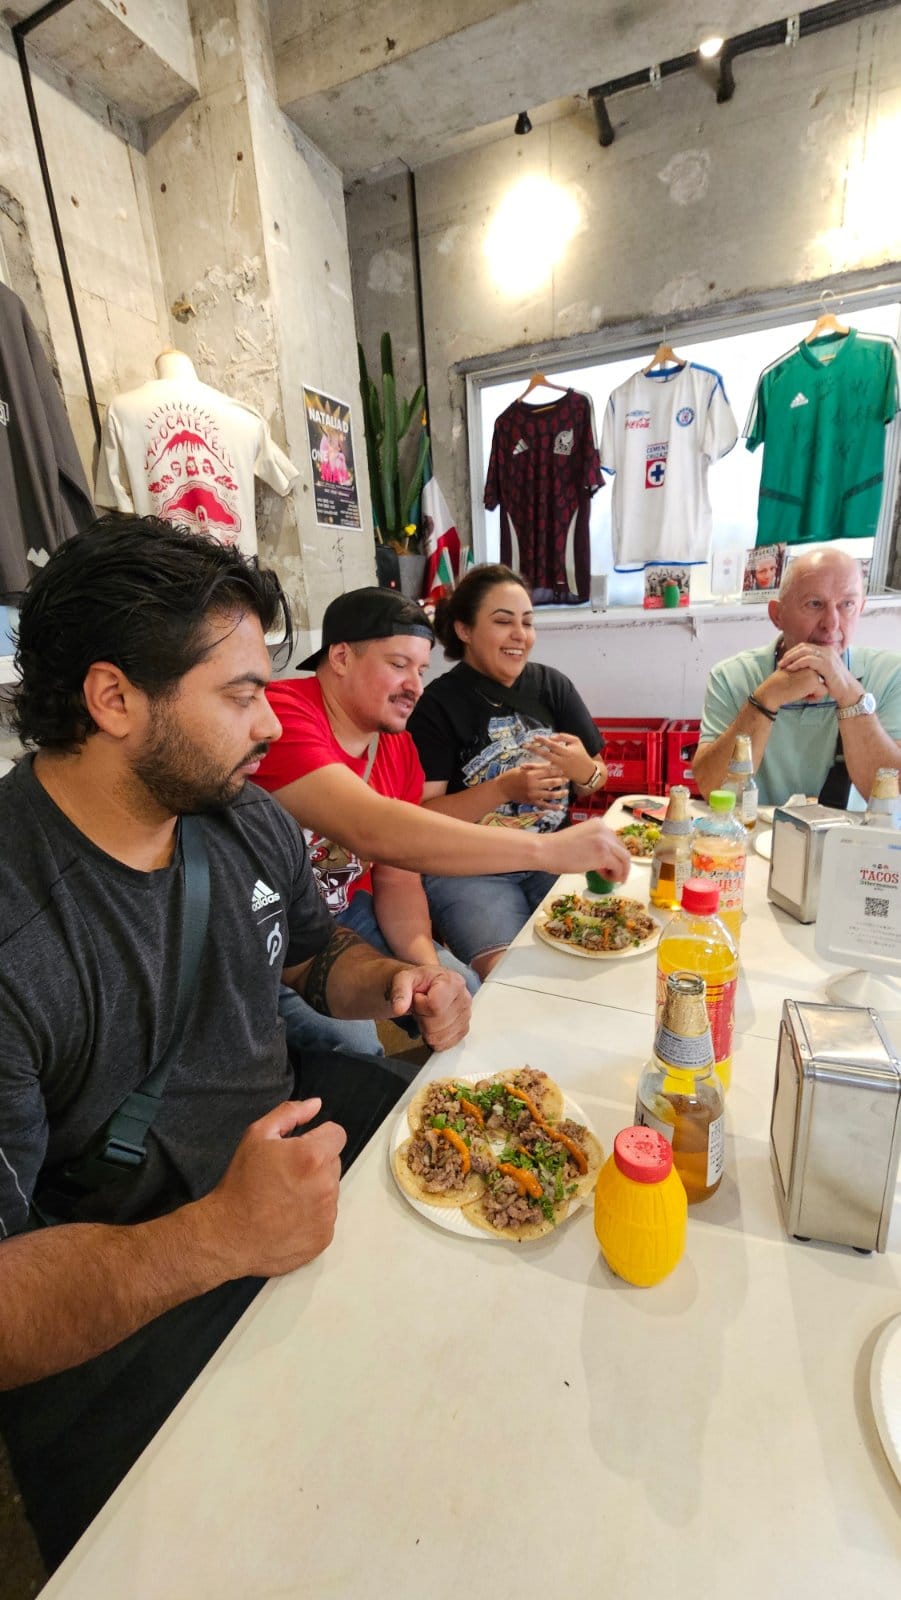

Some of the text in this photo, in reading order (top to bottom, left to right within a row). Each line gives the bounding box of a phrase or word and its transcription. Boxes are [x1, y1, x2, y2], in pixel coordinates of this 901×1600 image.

[646, 445, 669, 454] CEMENT
[859, 869, 900, 884] TACOS
[252, 893, 280, 911] adidas
